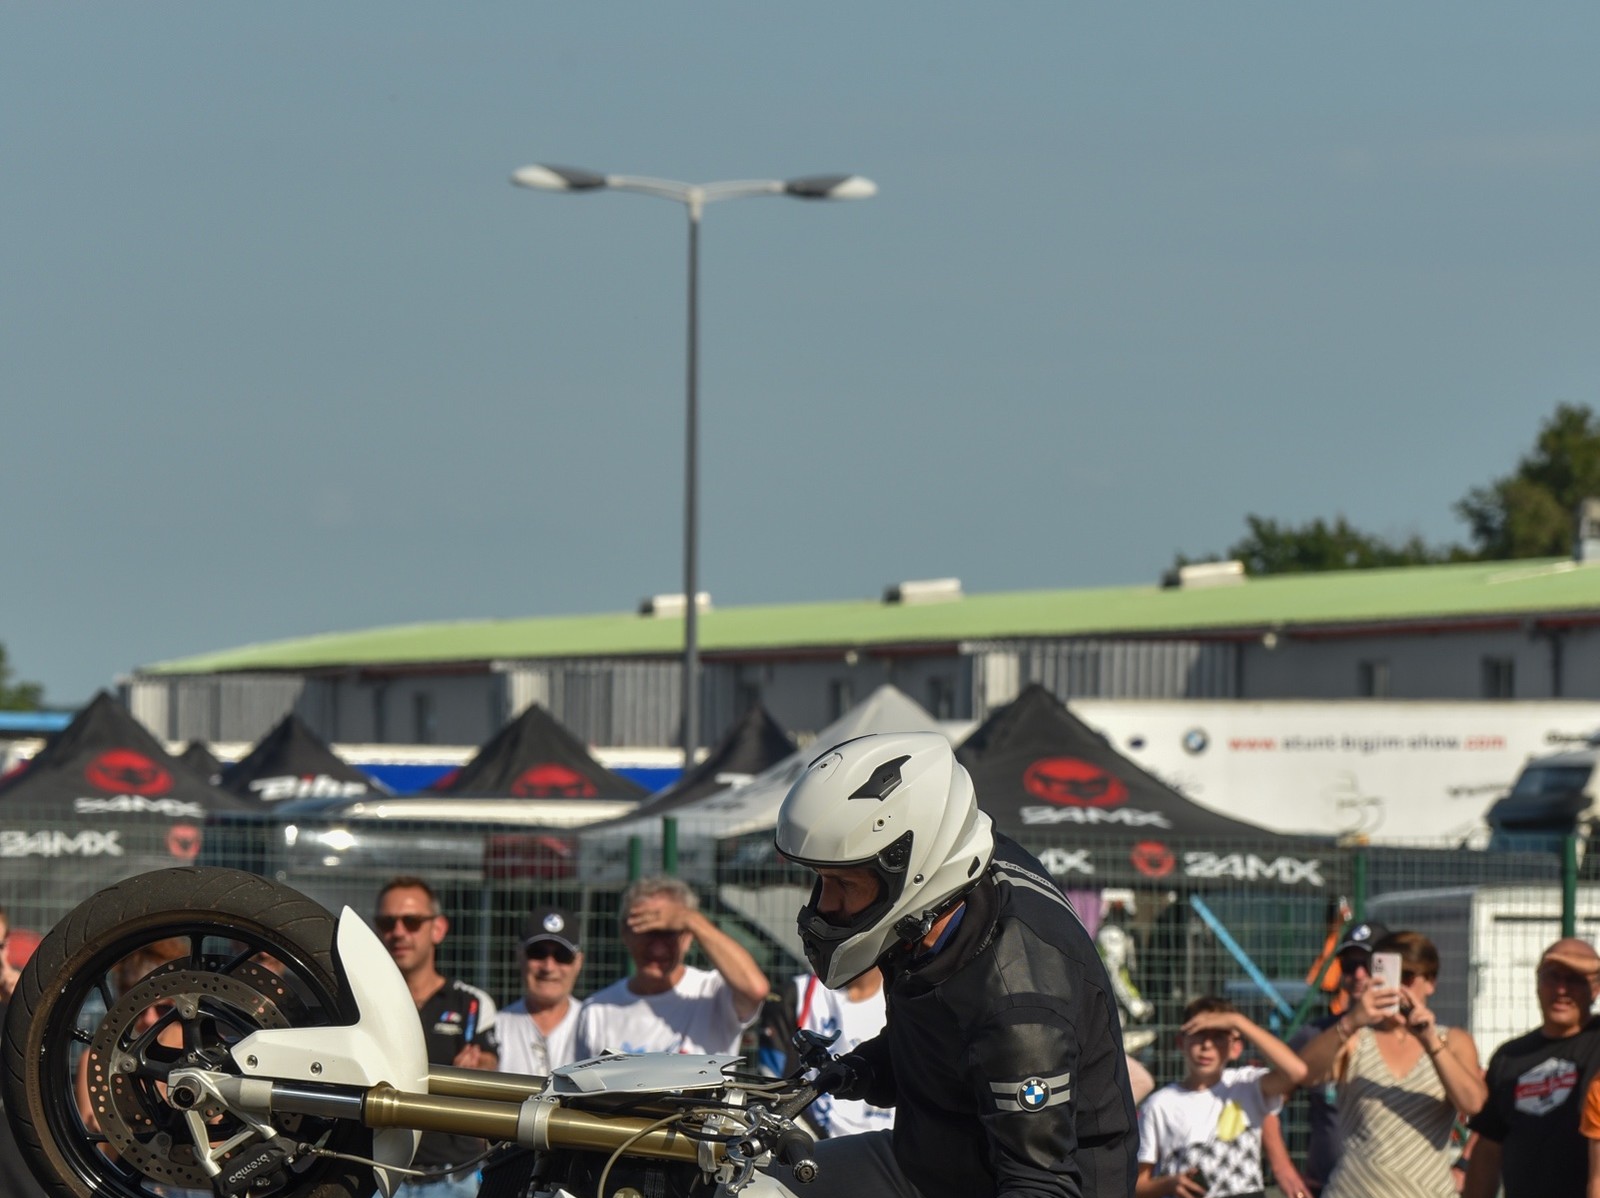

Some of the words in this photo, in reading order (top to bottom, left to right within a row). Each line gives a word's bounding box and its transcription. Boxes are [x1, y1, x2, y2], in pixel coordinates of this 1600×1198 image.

[1019, 805, 1173, 829] 24MX
[0, 830, 124, 858] 24MX
[1184, 851, 1325, 887] 24MX
[1021, 1079, 1047, 1091] BMW
[228, 1153, 271, 1183] brembo
